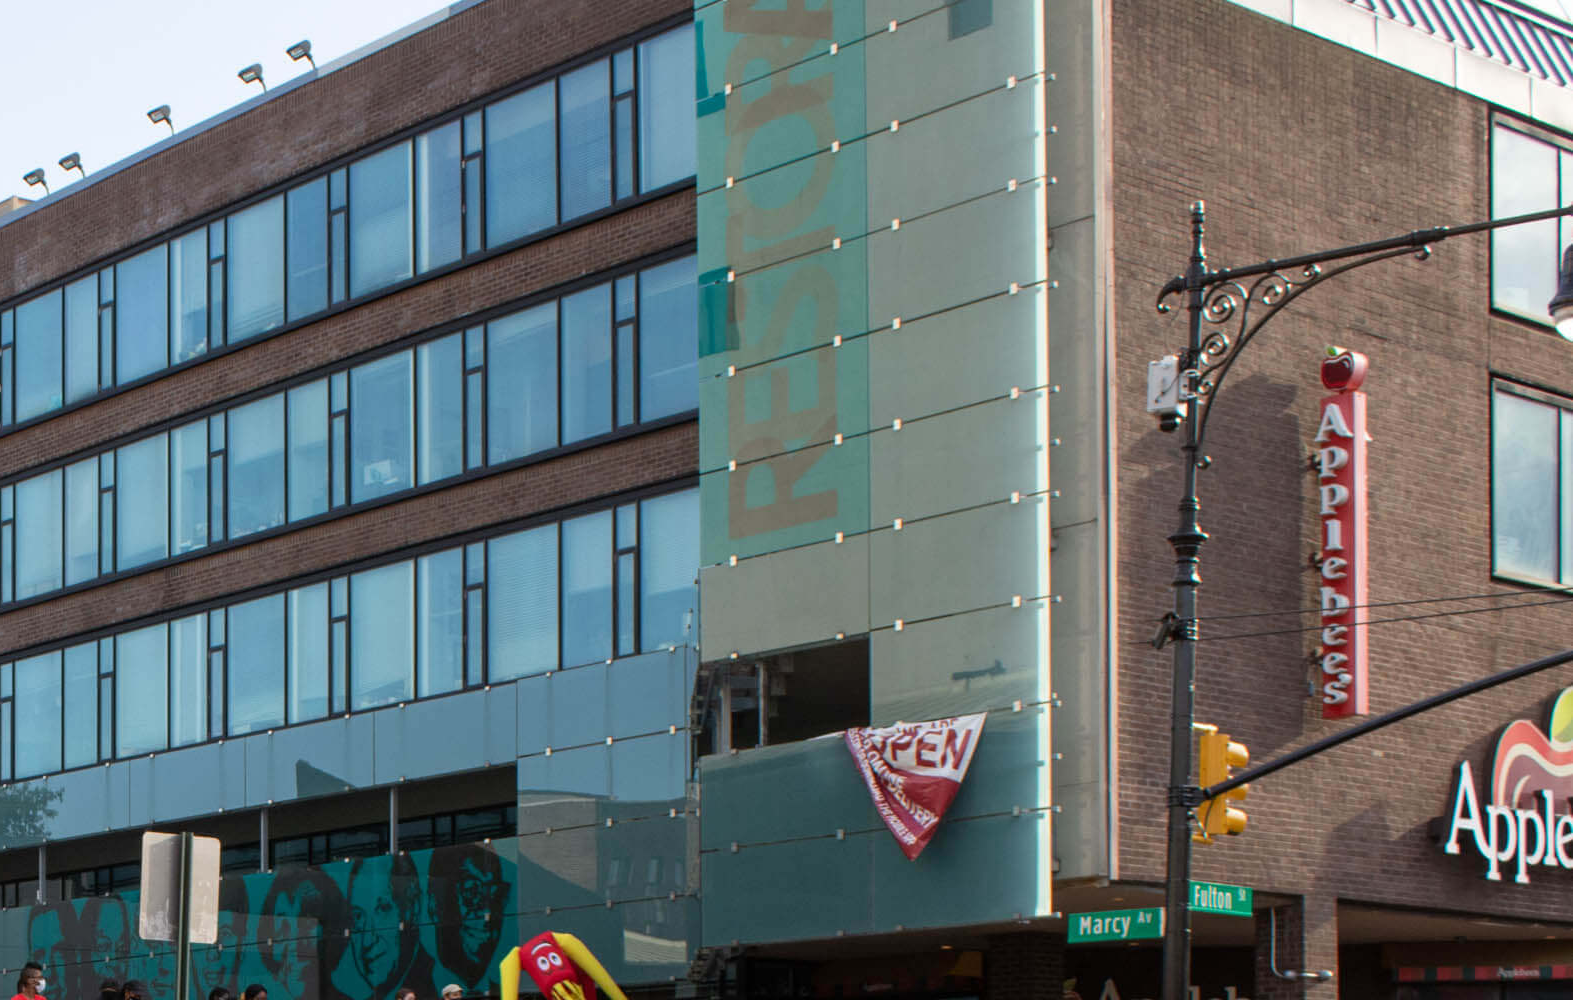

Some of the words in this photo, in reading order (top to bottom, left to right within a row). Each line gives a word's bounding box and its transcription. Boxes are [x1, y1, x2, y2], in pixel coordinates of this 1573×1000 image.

[1315, 403, 1354, 705] Applebee's
[1194, 885, 1233, 910] Fulton
[1079, 916, 1131, 938] Marcy
[1137, 911, 1153, 924] Av
